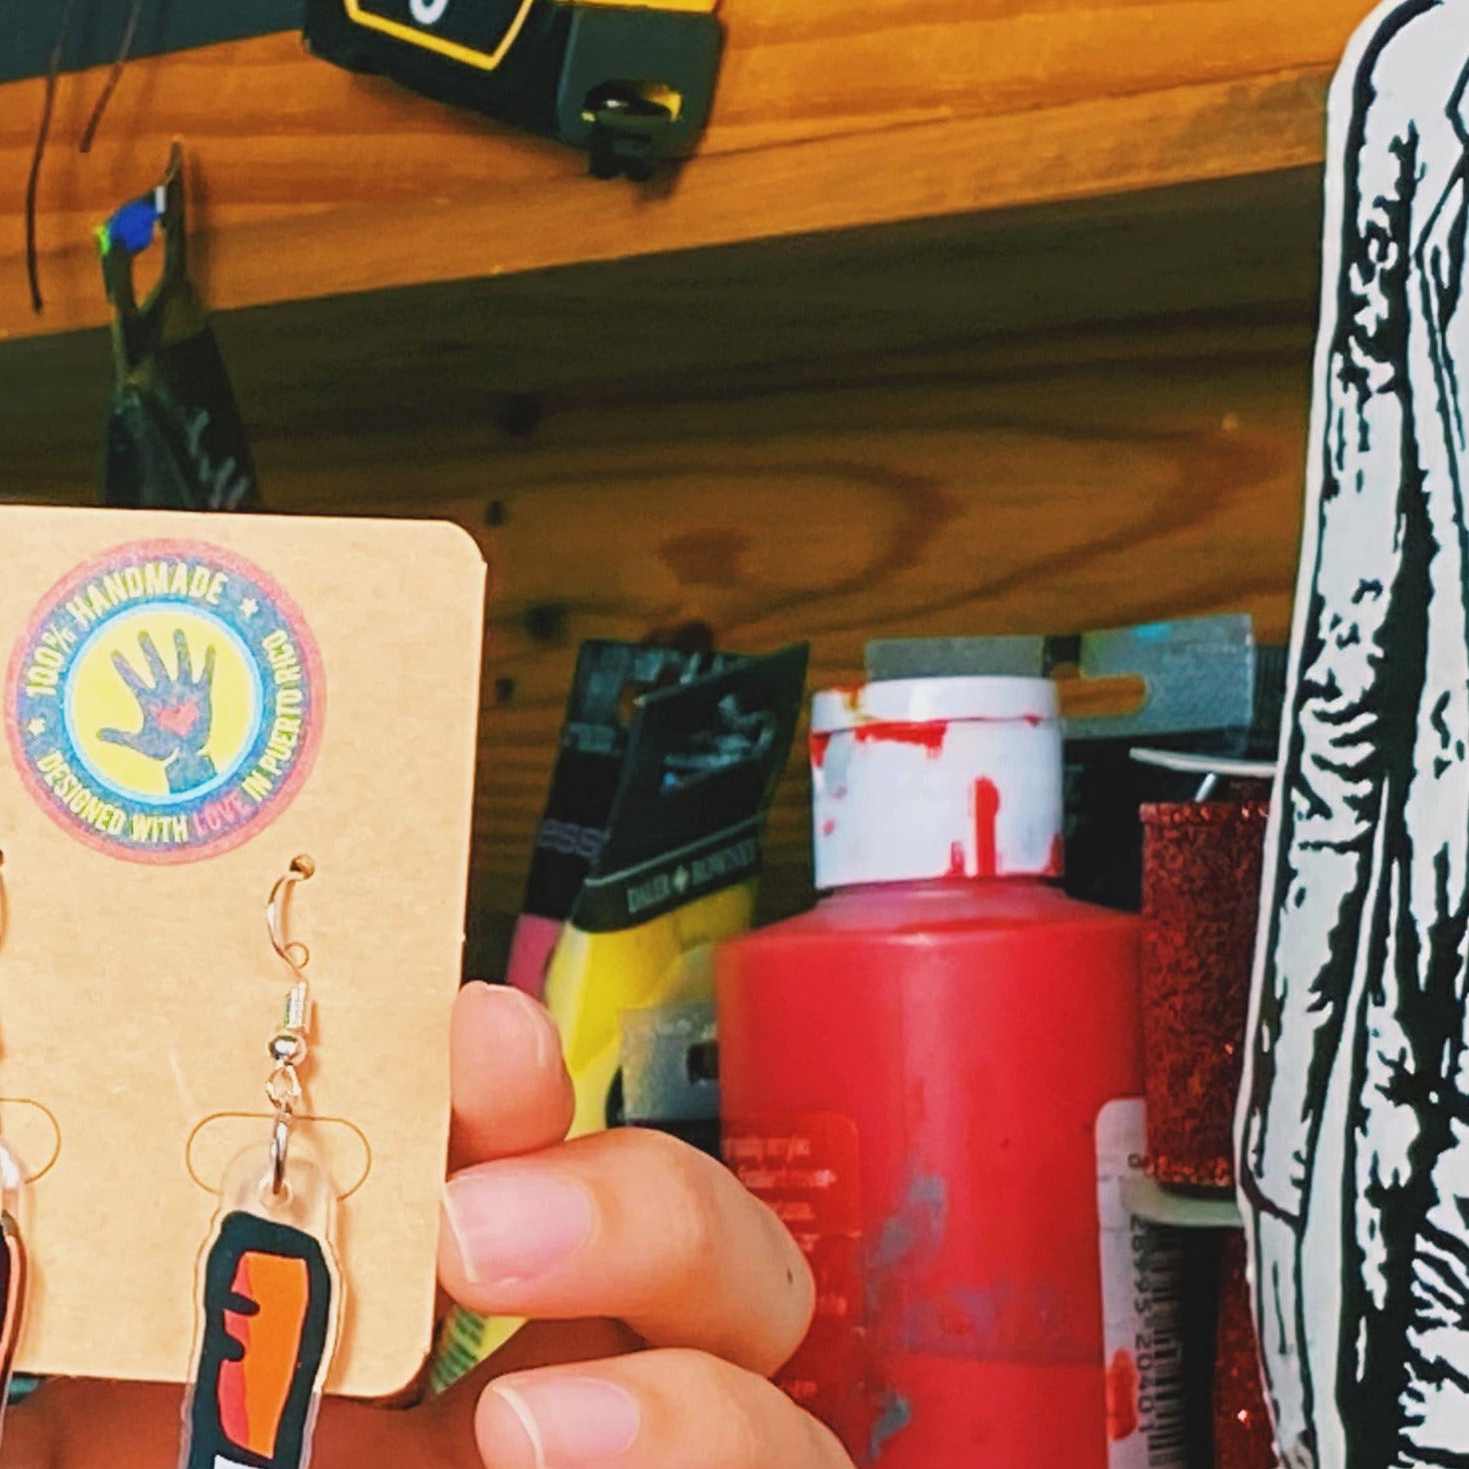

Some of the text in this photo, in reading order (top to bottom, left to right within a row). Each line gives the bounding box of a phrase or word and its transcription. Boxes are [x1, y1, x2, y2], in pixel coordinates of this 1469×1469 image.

[25, 560, 229, 698] 100% HANDMADE
[36, 628, 304, 844] DESIGNED WITH LOVE IN PUERTO RICO
